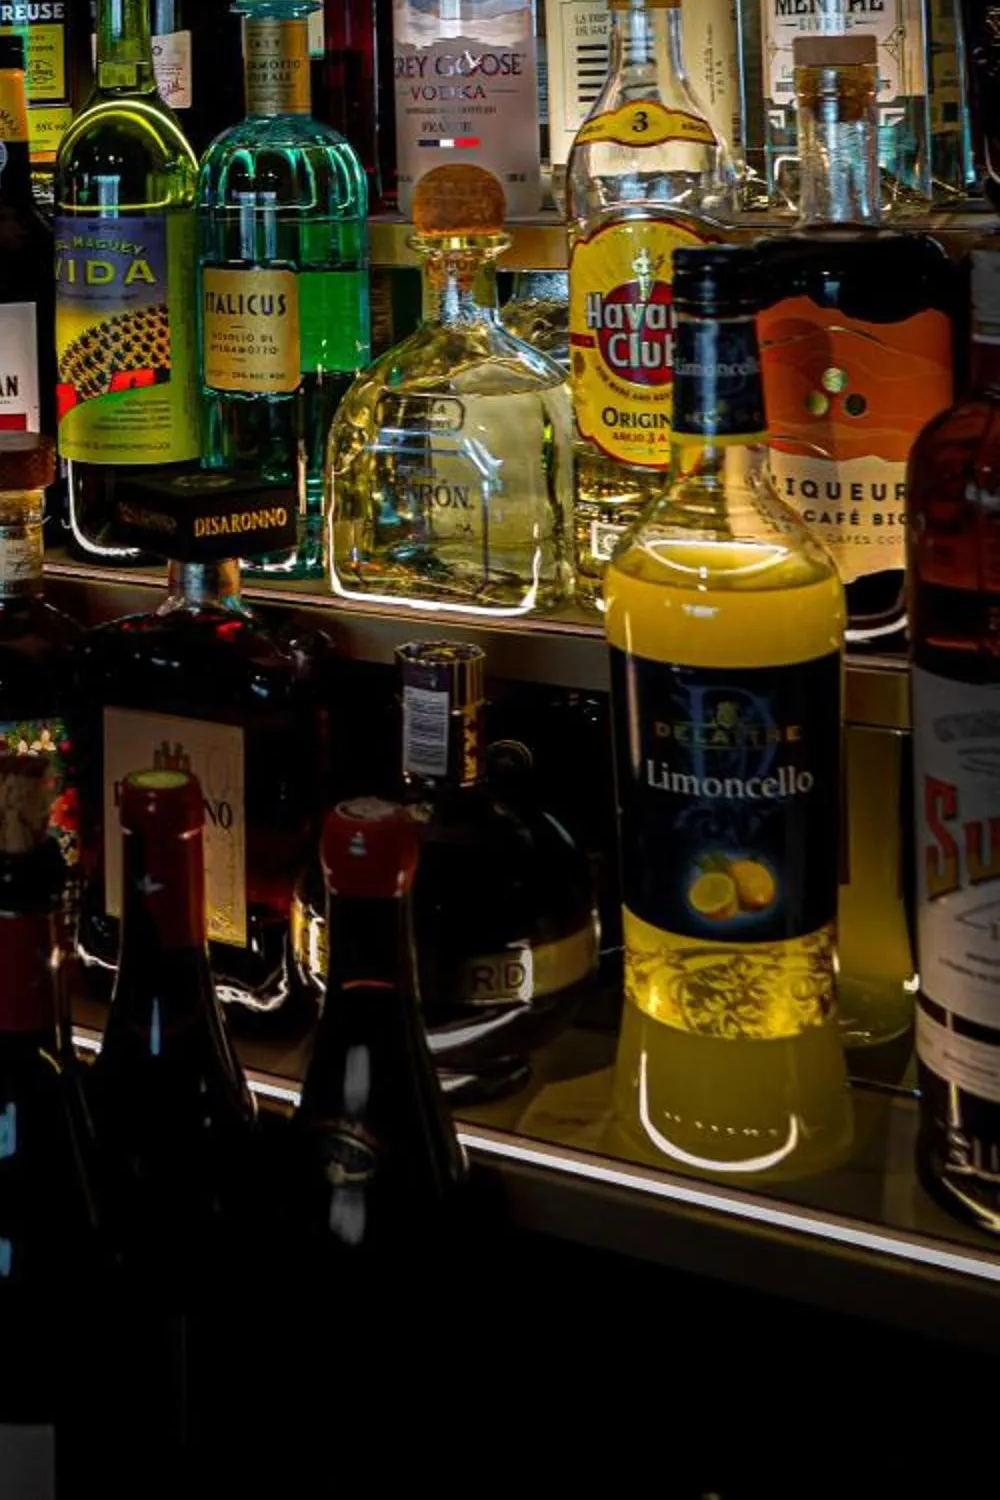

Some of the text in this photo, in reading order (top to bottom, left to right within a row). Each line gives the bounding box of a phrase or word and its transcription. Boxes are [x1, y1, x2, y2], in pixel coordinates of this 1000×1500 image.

[435, 53, 521, 77] GOOSE
[632, 111, 649, 133] 3
[205, 291, 287, 317] ITALICUS
[194, 506, 288, 538] DISARONNO
[802, 507, 858, 526] CAFÉ
[646, 758, 815, 800] Limoncello
